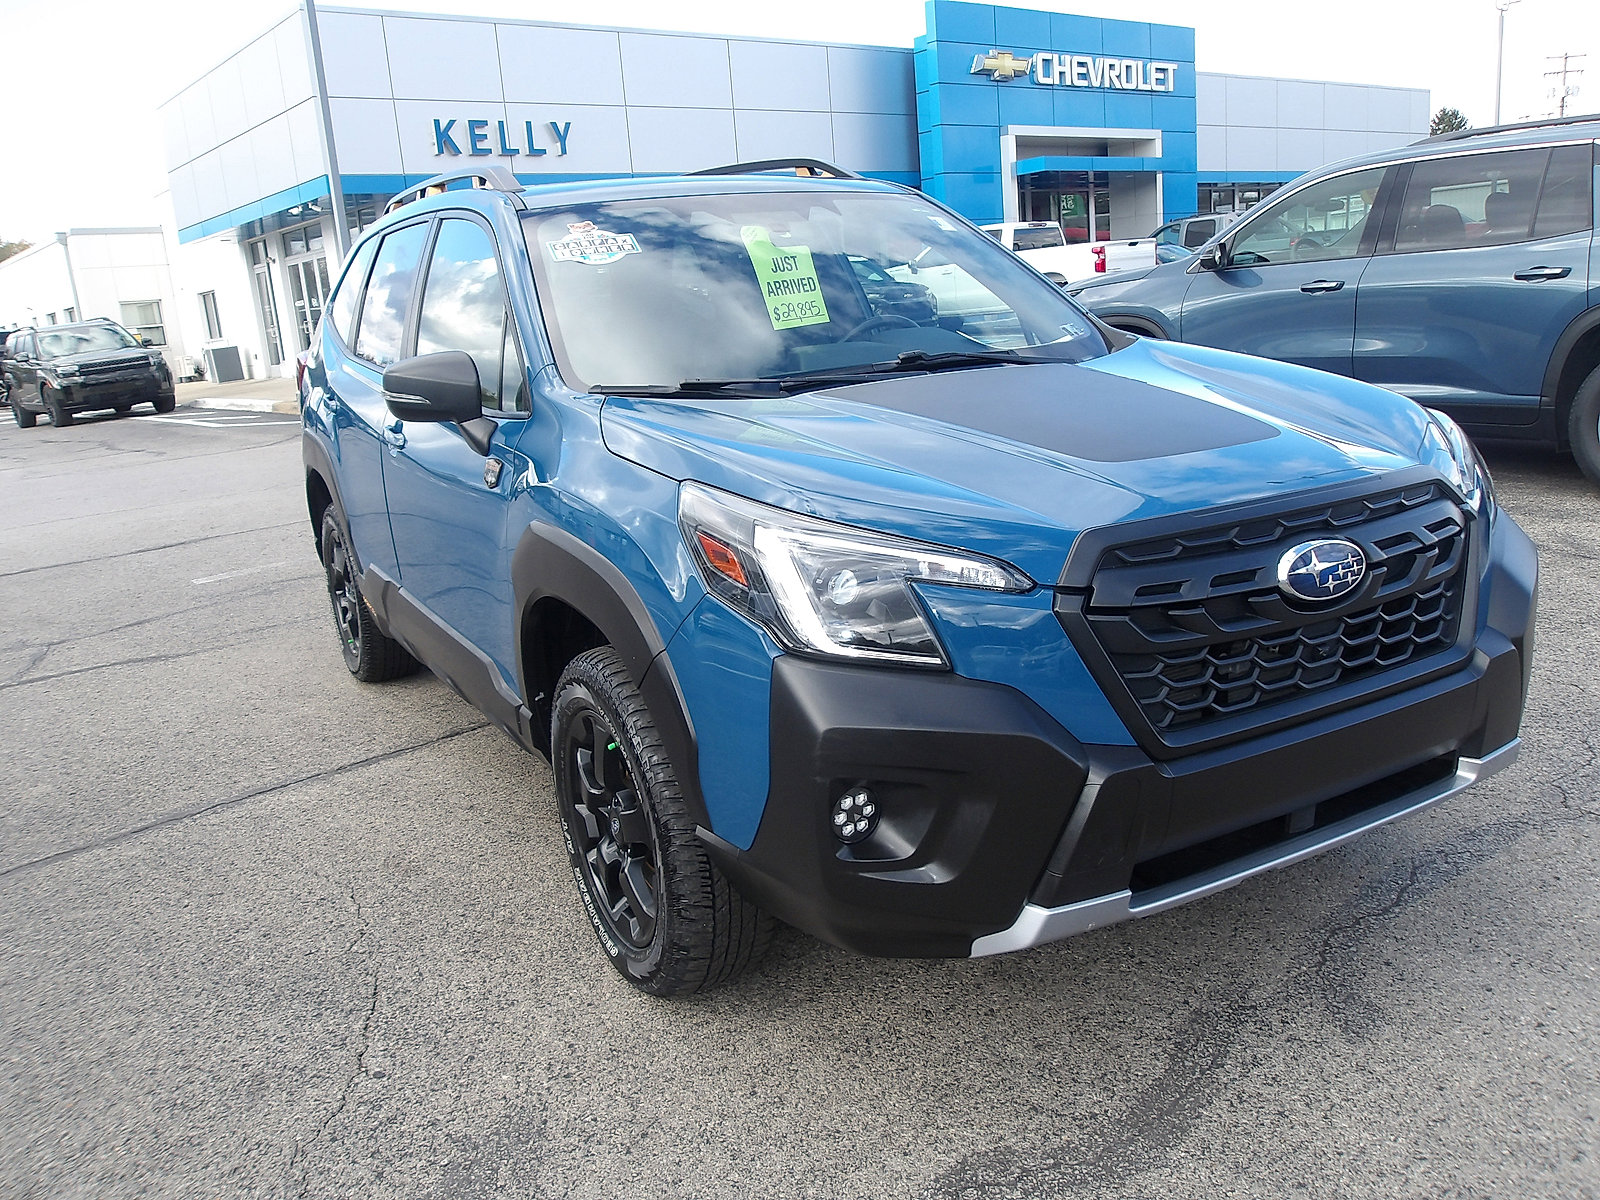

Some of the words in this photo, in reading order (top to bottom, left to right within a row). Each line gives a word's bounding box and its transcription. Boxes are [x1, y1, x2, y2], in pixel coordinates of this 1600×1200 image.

[1033, 52, 1178, 92] CHEVROLET
[432, 118, 571, 156] KELLY
[771, 255, 799, 274] JUST
[766, 276, 817, 298] ARRIVED
[773, 300, 822, 323] $29,895
